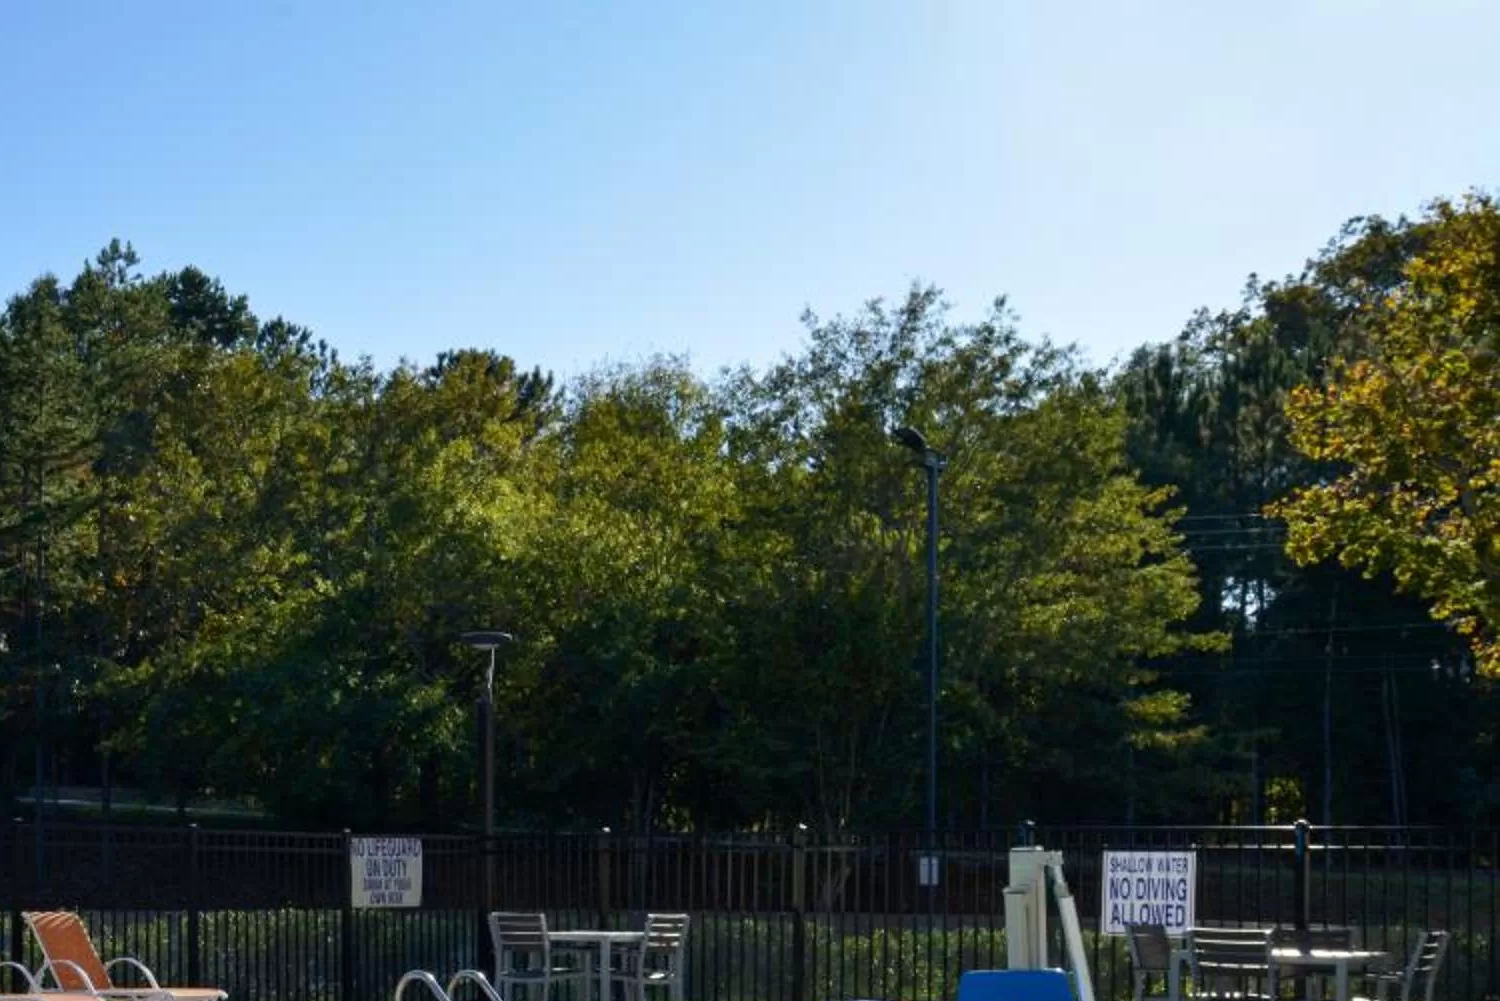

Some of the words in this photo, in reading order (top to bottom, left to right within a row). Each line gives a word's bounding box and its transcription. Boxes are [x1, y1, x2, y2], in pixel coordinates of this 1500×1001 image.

[367, 838, 421, 857] LIFEGUARD
[382, 859, 407, 877] DUTY
[1110, 857, 1153, 873] SHALLOW
[1157, 857, 1188, 873] WATER
[1110, 878, 1131, 900] NO
[1136, 877, 1187, 901] DIVING
[1110, 903, 1186, 927] ALLOWED
